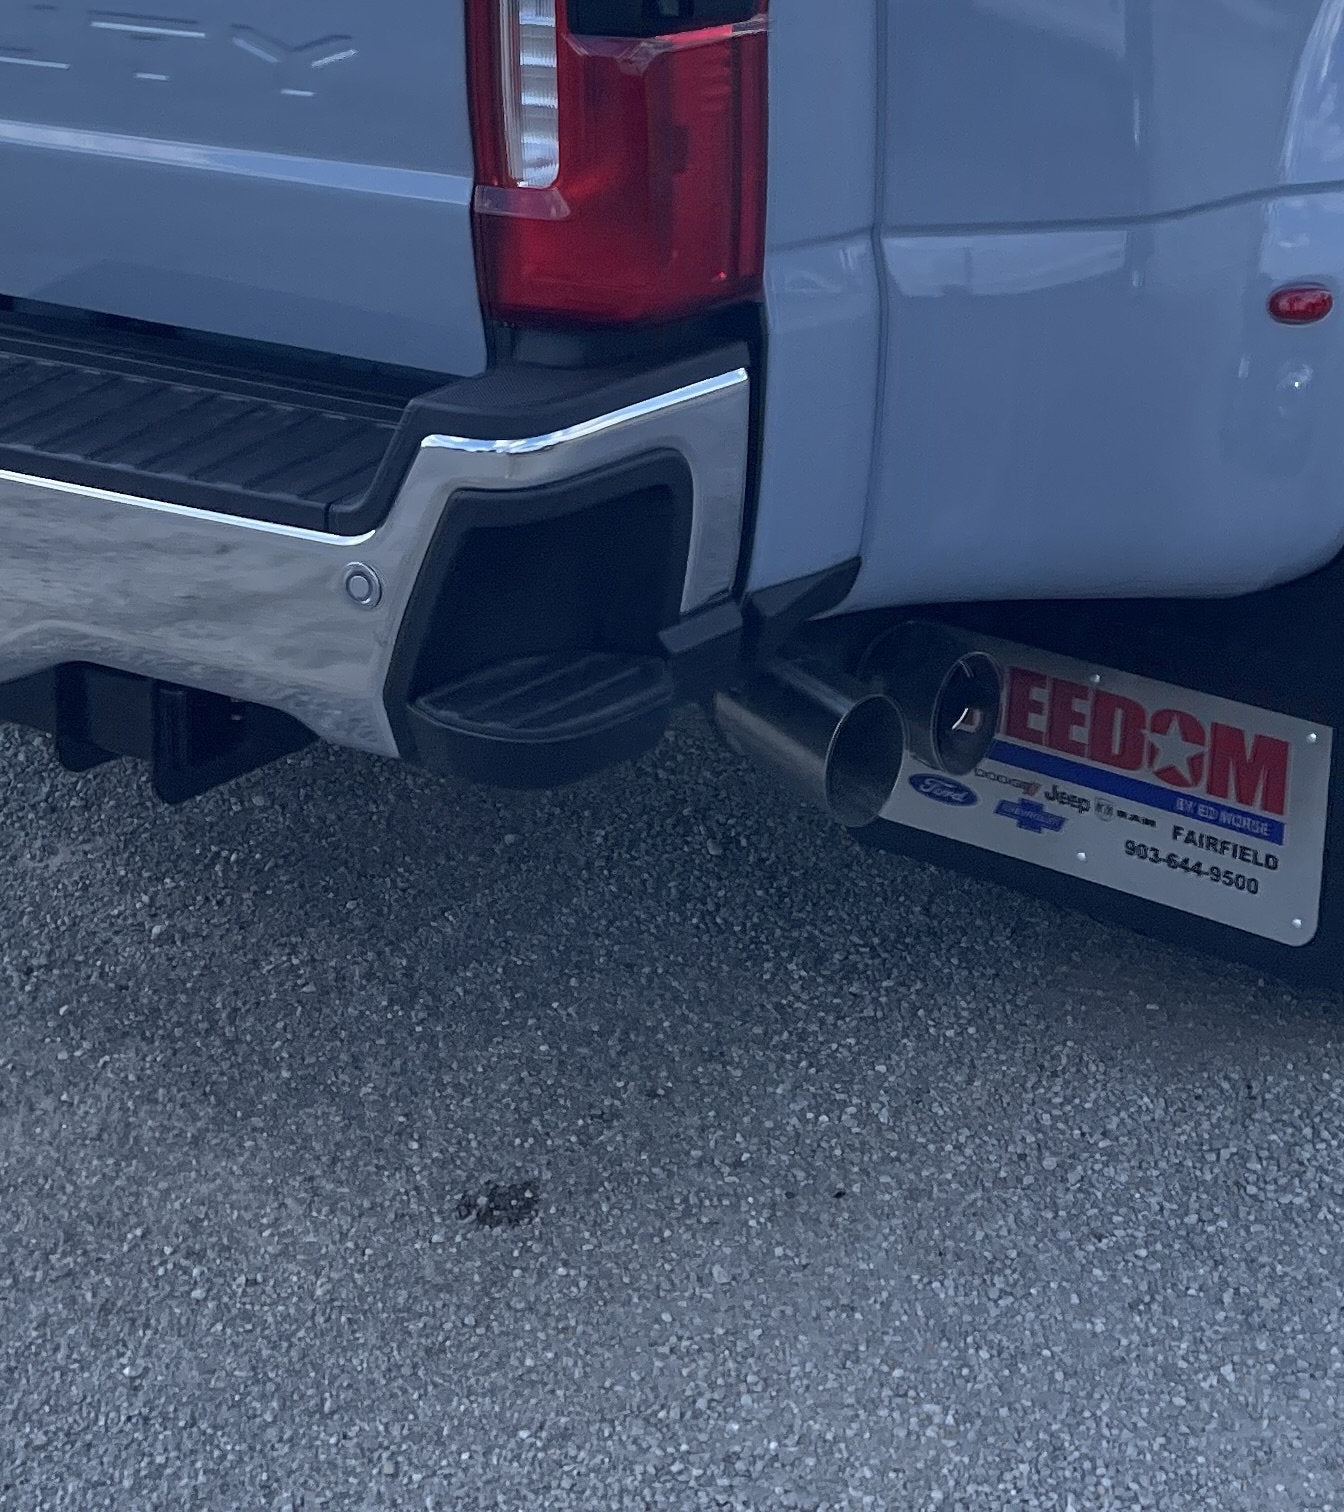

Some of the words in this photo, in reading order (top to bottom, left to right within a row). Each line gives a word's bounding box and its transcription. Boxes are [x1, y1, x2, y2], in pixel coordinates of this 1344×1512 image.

[1005, 666, 1289, 815] EEDOM
[920, 778, 968, 802] Ford
[1044, 785, 1091, 813] Jeep
[1125, 839, 1259, 894] 903-644-9500
[1172, 825, 1279, 870] FAIRFIELD
